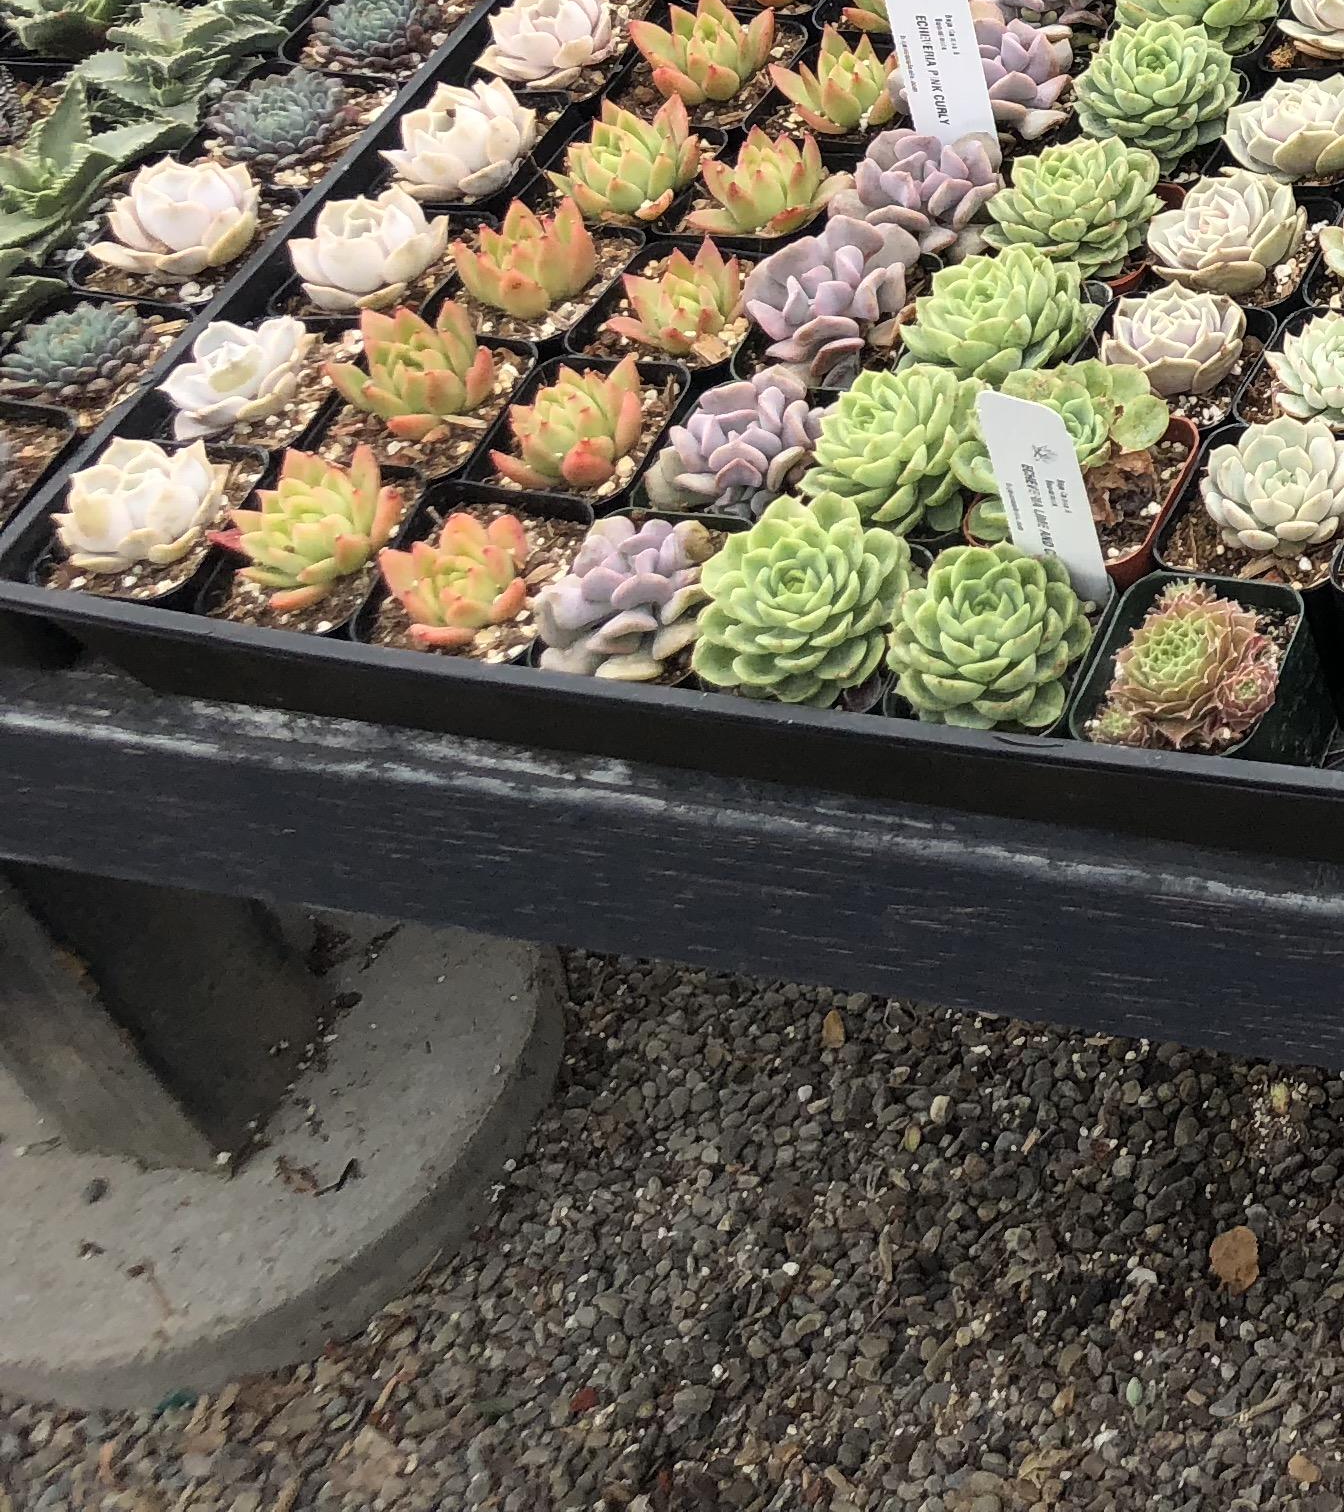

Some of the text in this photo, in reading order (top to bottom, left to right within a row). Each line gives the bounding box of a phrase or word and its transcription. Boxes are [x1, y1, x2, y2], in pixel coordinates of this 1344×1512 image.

[915, 15, 937, 67] ECHEERIA
[927, 69, 943, 93] PNK
[933, 94, 951, 126] CURLY
